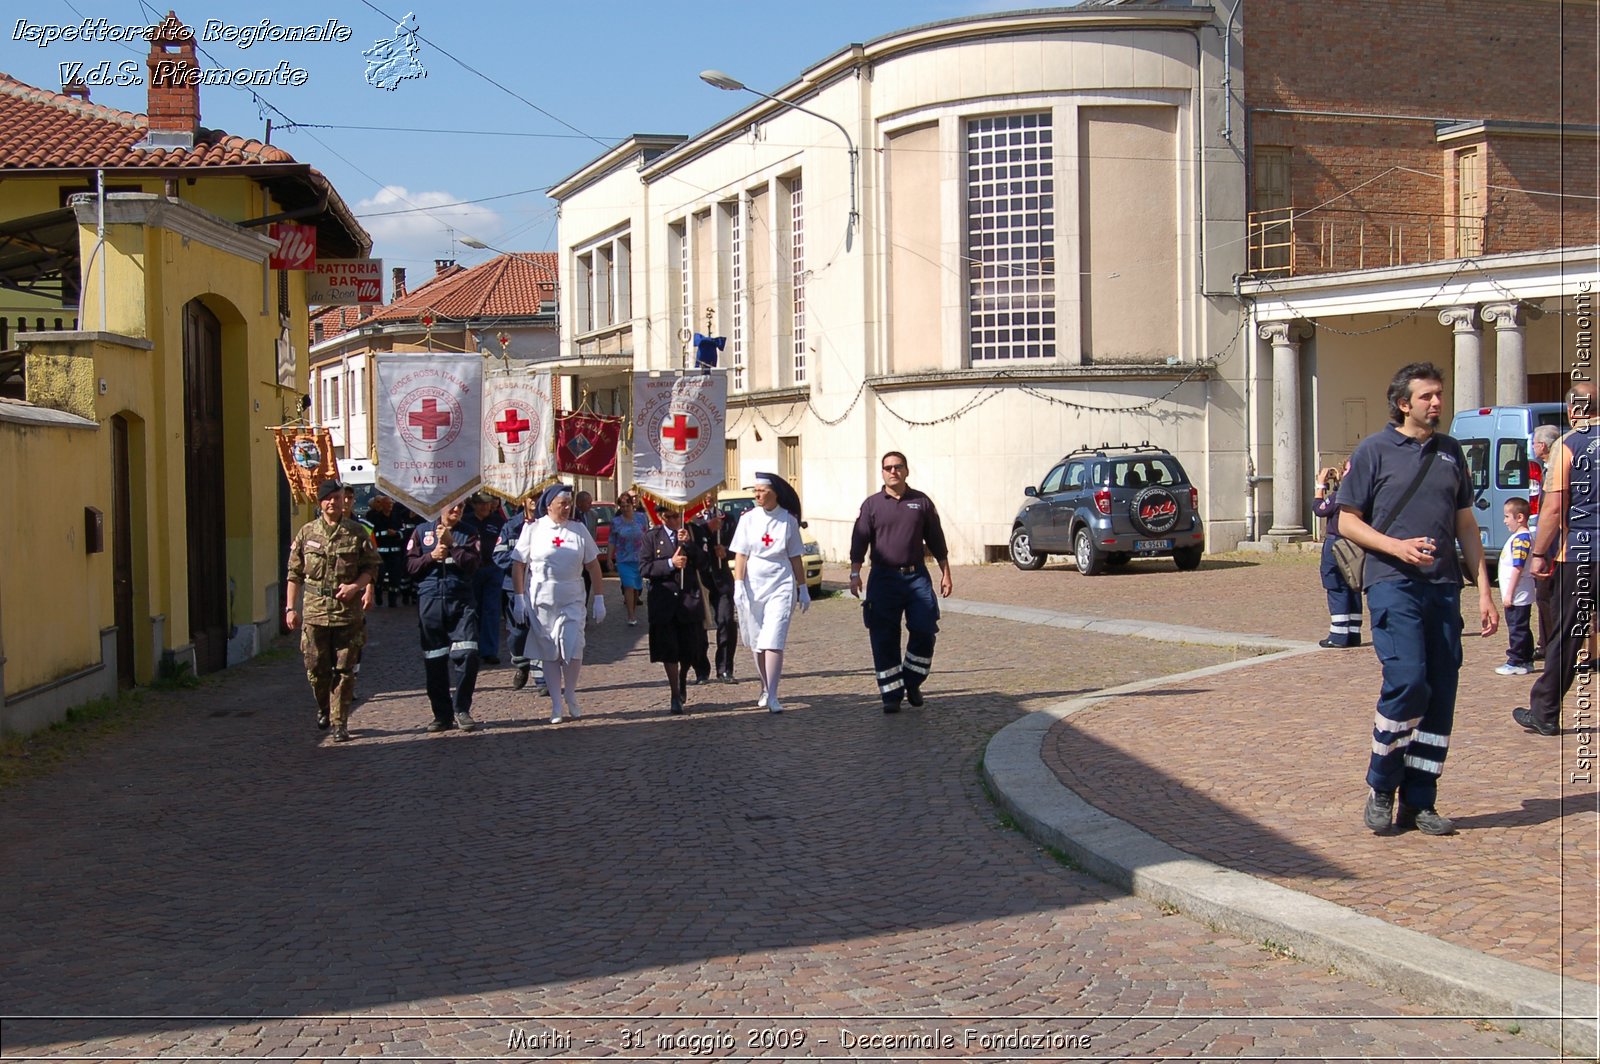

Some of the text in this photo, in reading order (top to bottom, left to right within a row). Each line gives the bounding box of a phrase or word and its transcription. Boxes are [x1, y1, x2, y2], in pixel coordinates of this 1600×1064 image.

[272, 231, 314, 266] illy
[330, 276, 359, 287] BAR
[311, 288, 355, 302] da Rosa
[358, 281, 380, 300] illy
[390, 375, 413, 396] CROCE
[413, 369, 439, 378] ROSSA
[441, 371, 470, 394] ITALIANA
[636, 398, 658, 427] CROCE
[394, 461, 454, 470] DELEGAZIONE
[647, 468, 711, 479] COMITATO LOCALE
[413, 475, 448, 485] MATHI
[665, 480, 695, 489] FIANO
